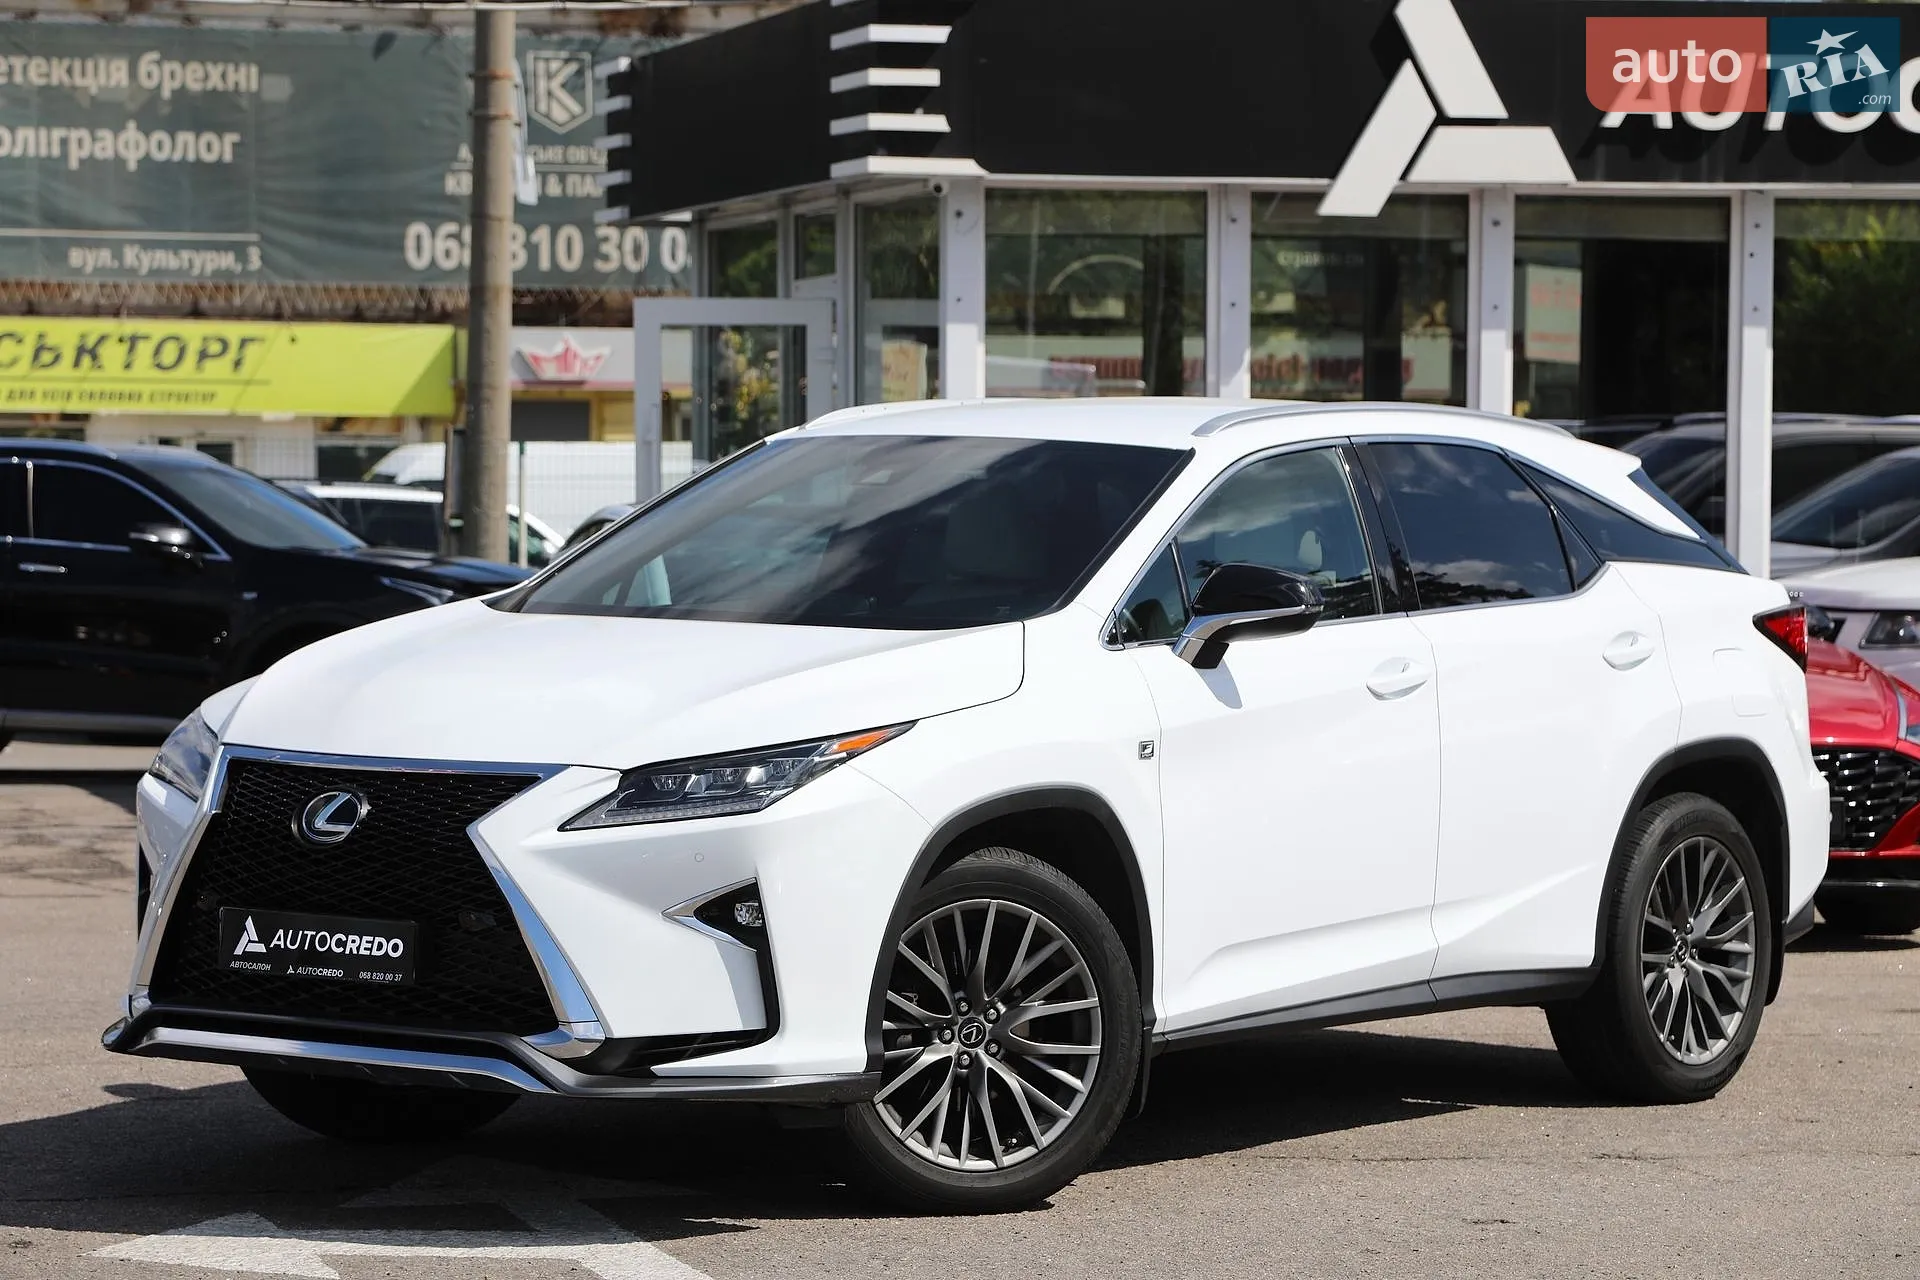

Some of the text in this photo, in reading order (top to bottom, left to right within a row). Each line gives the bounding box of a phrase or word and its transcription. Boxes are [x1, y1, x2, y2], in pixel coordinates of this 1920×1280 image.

[137, 51, 259, 100] брехні
[68, 244, 262, 276] вул. Культури, 3
[594, 226, 650, 273] 30
[269, 928, 404, 958] AUTOCREDO
[229, 960, 272, 971] АВТОСАЛОН
[296, 966, 344, 977] AUTOCREDO
[372, 972, 385, 981] 820
[384, 973, 394, 981] 00
[394, 973, 403, 982] 37
